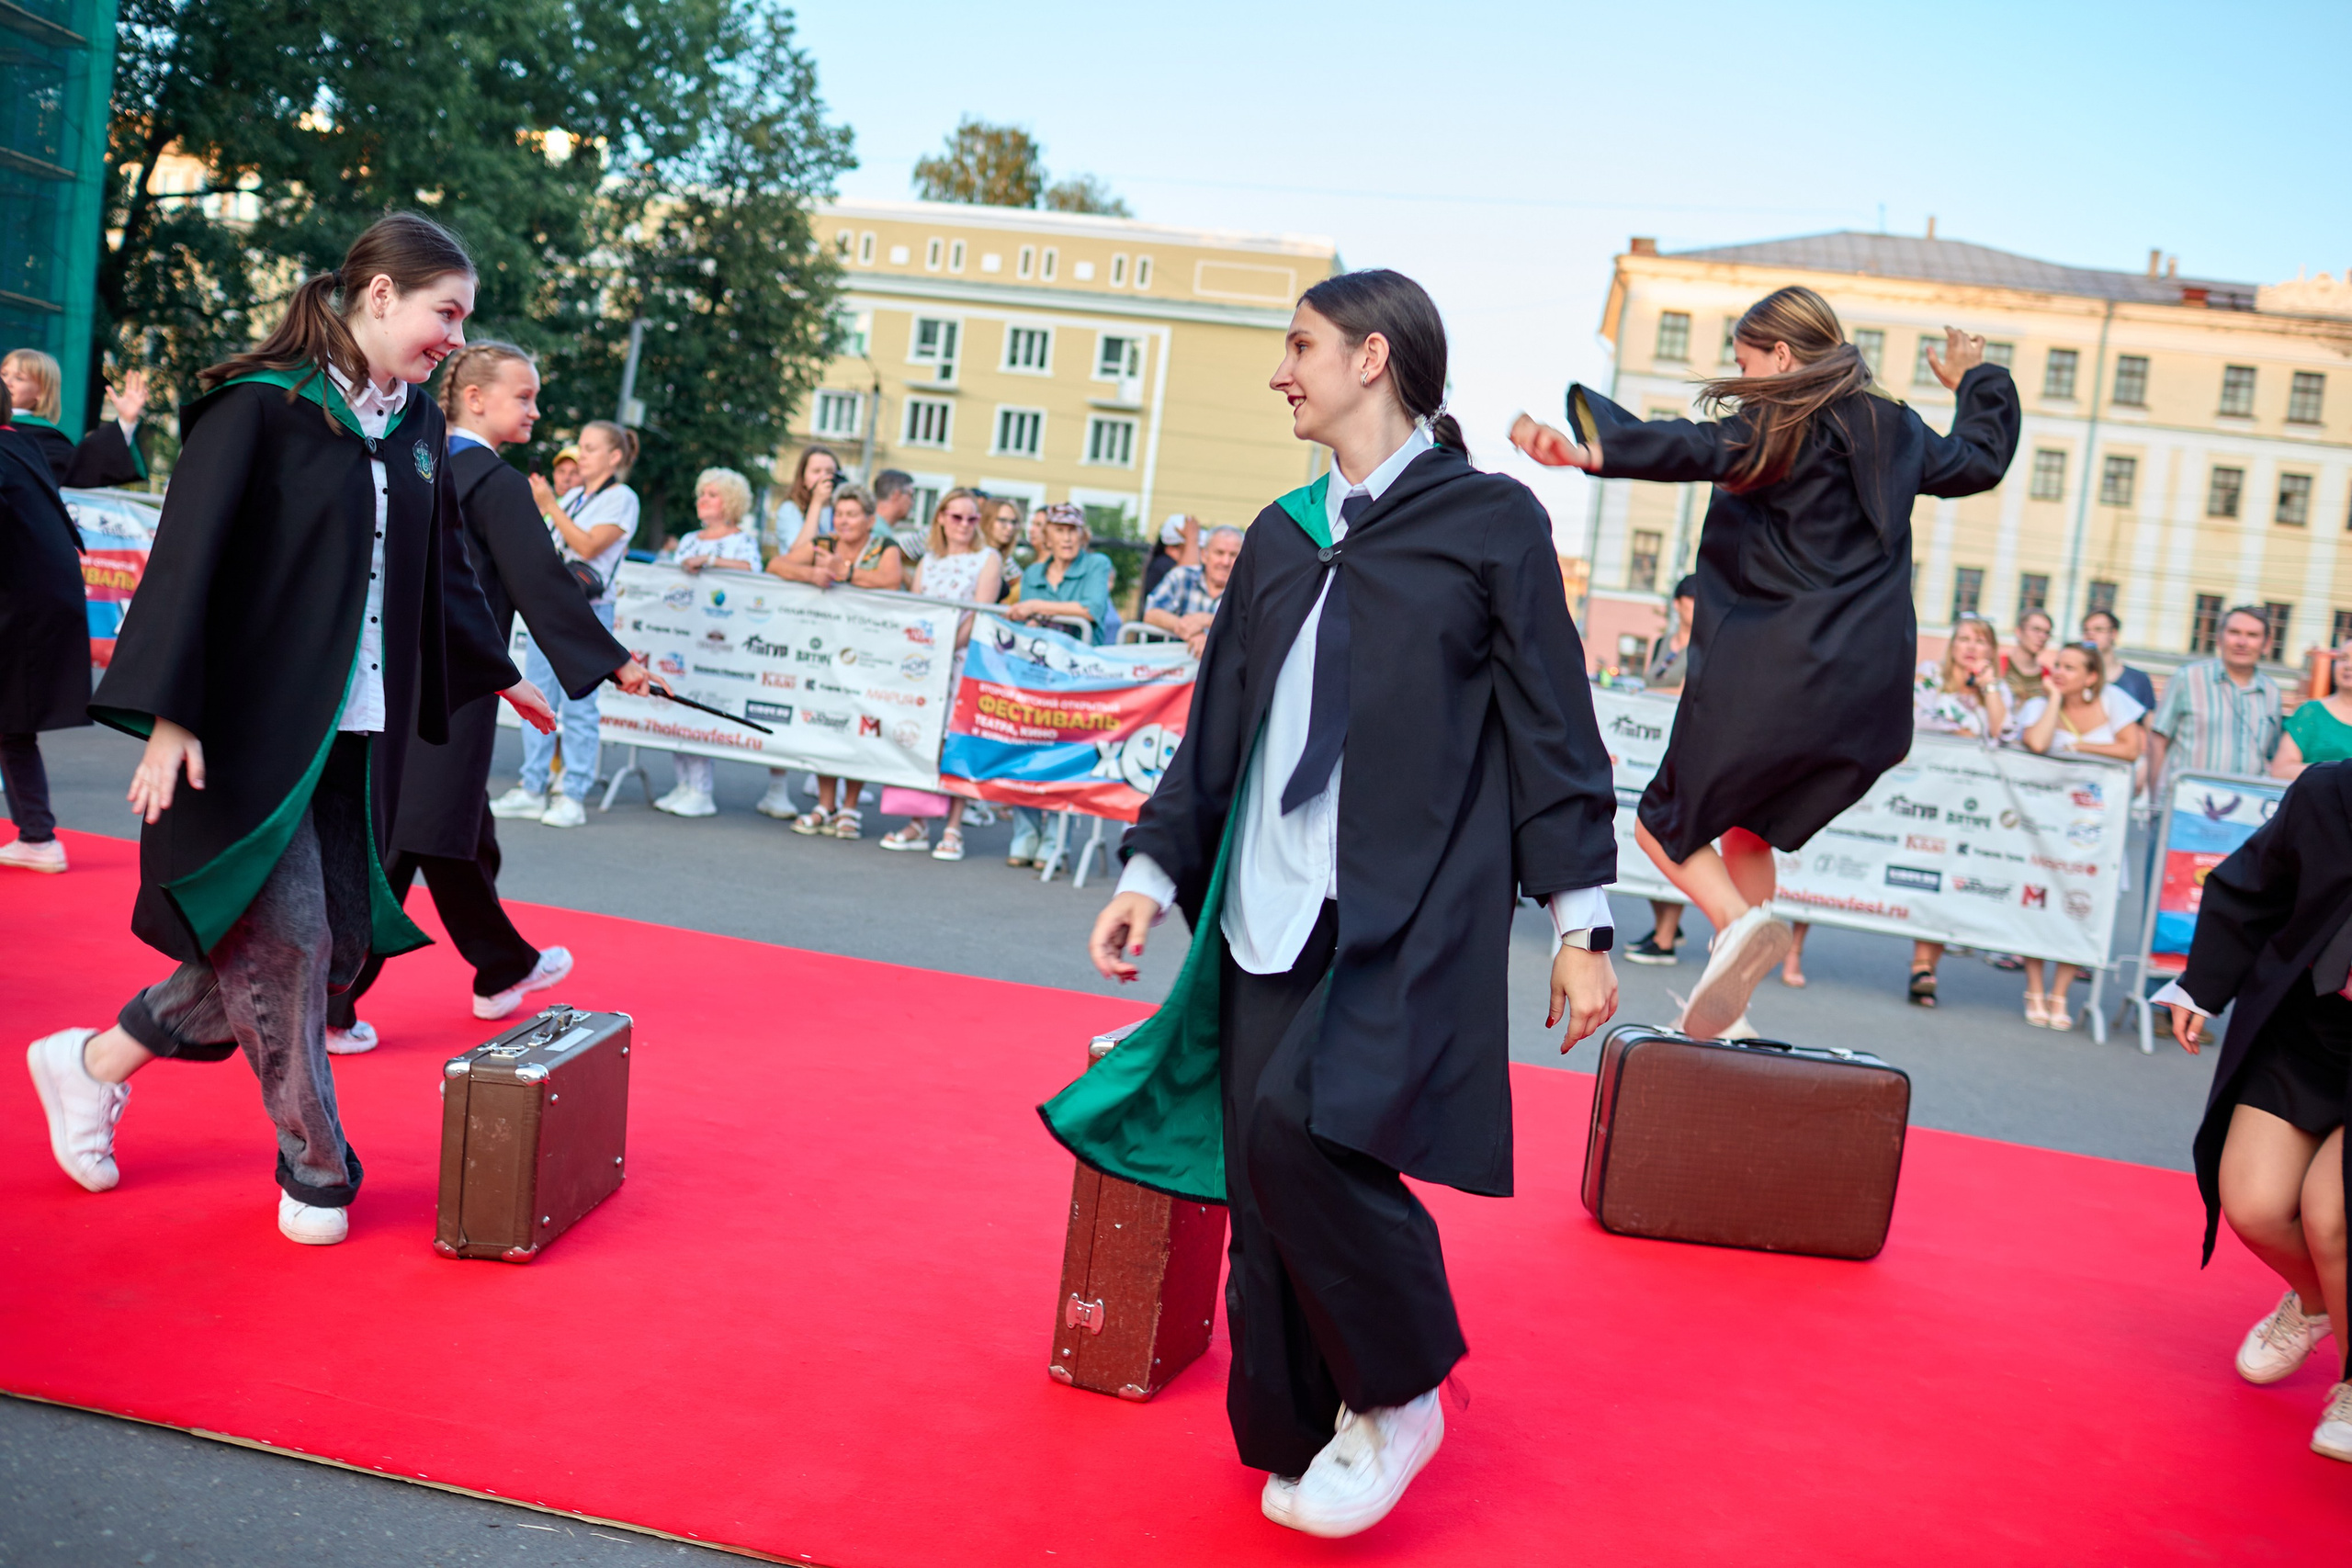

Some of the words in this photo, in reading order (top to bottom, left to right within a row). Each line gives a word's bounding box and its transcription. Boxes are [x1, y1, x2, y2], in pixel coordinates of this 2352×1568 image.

[975, 714, 1018, 736] ТЕАТРА,
[1019, 727, 1058, 740] КИНО
[978, 694, 1122, 732] ФЕСТИВАЛЬ
